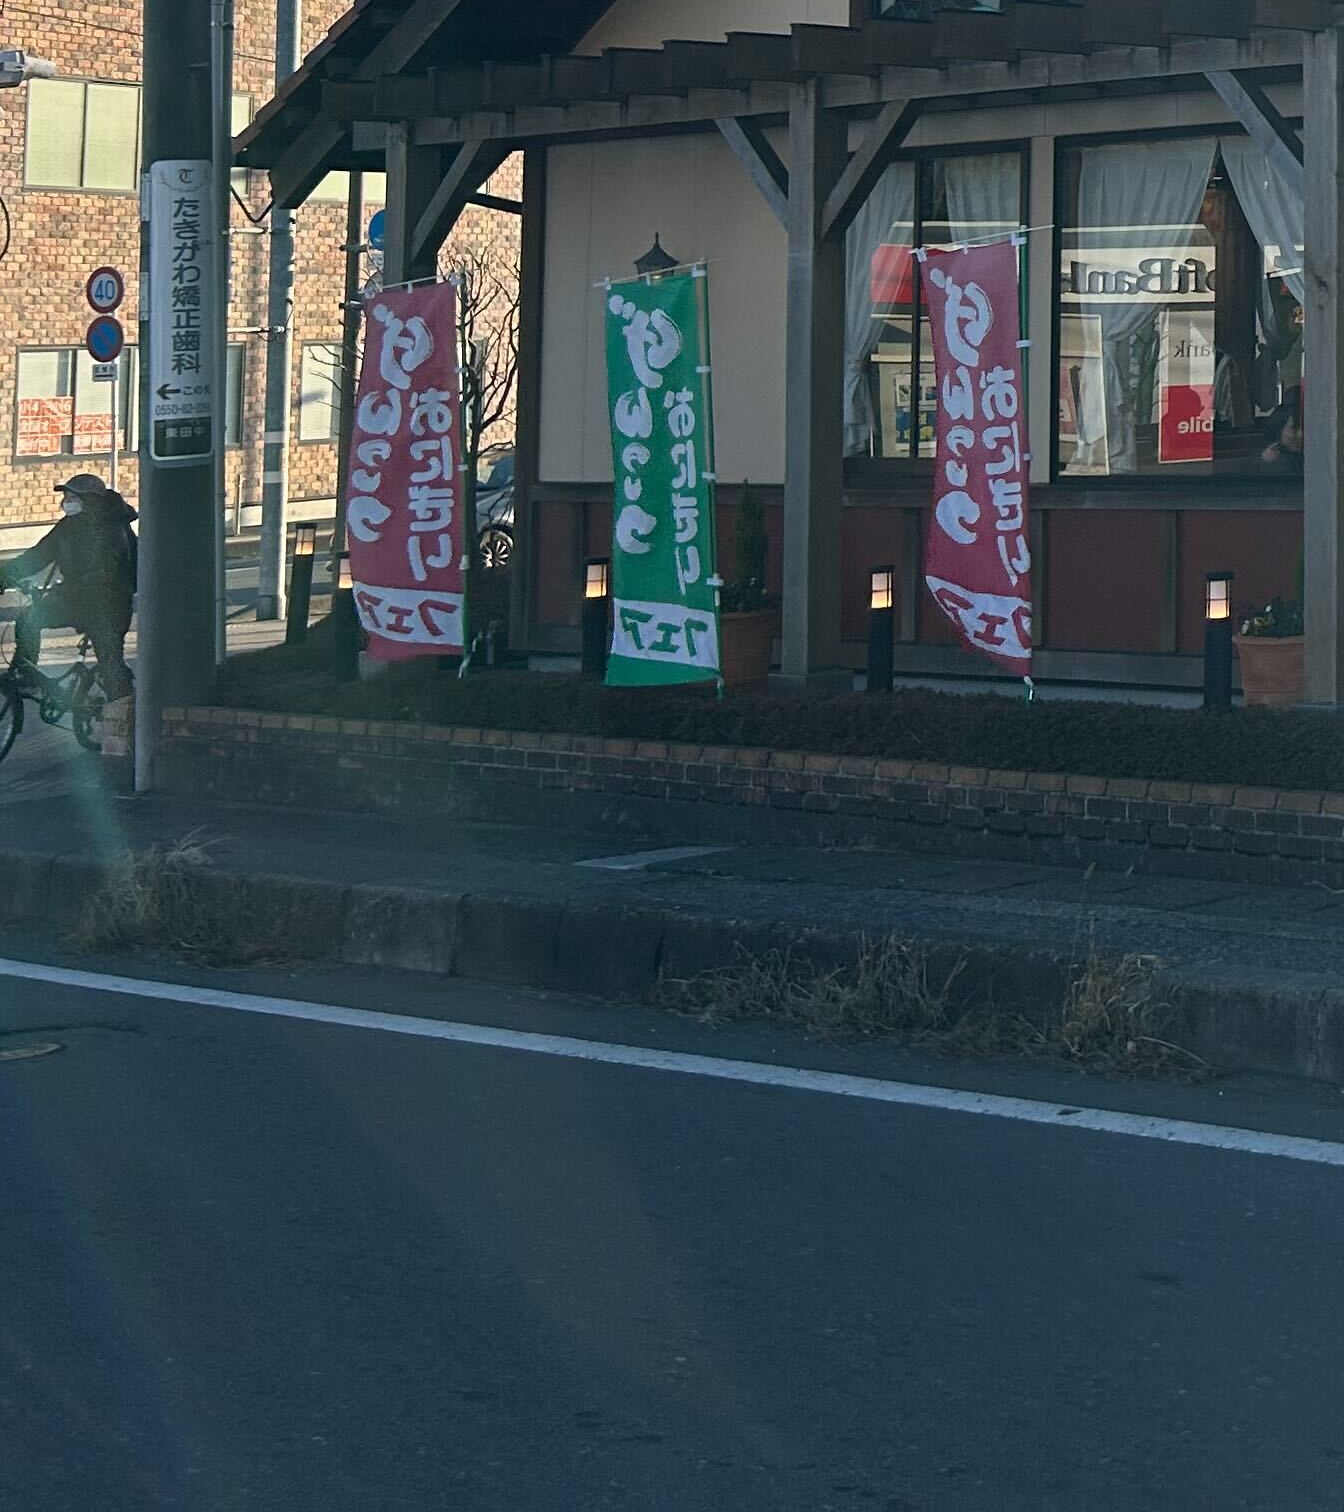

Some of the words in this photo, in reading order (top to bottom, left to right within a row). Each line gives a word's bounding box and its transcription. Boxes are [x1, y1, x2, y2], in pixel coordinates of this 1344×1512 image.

[95, 279, 115, 301] 40
[172, 197, 201, 375] たきがわ矯正歯科
